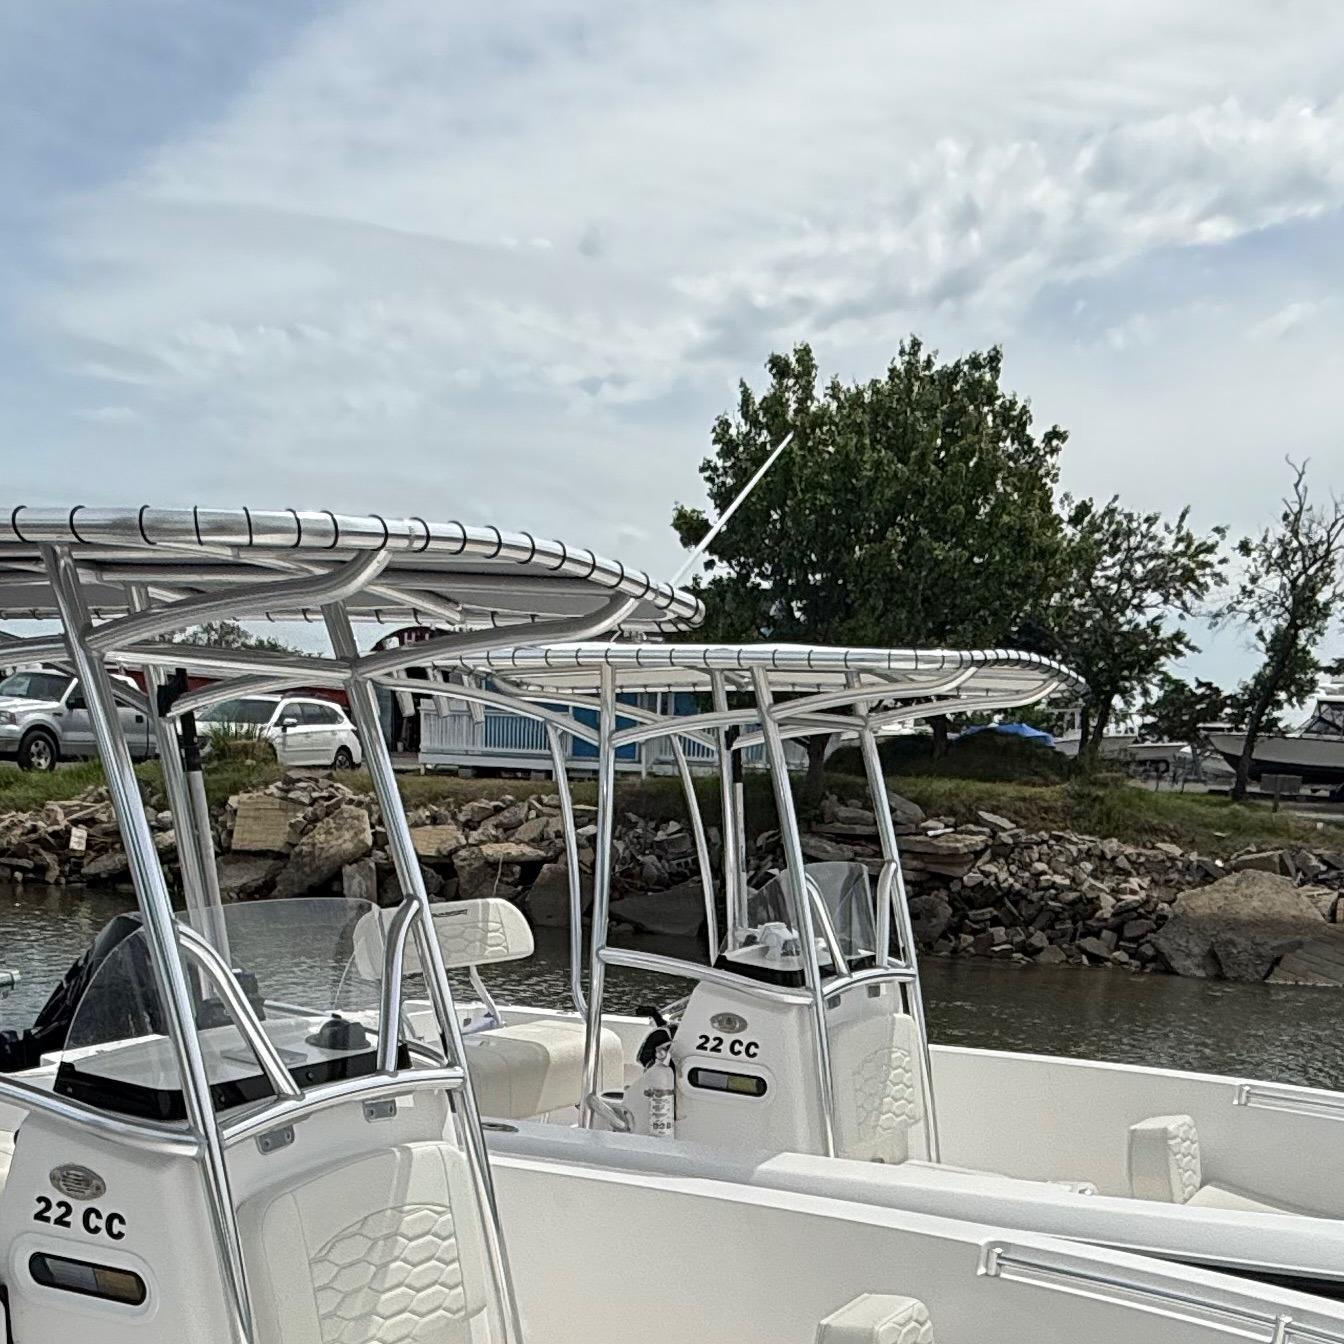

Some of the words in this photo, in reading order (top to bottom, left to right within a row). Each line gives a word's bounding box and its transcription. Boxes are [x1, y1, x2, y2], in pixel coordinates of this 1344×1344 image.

[696, 1034, 724, 1054] 22
[729, 1039, 760, 1059] CC
[33, 1195, 73, 1229] 22
[82, 1206, 127, 1241] CC
